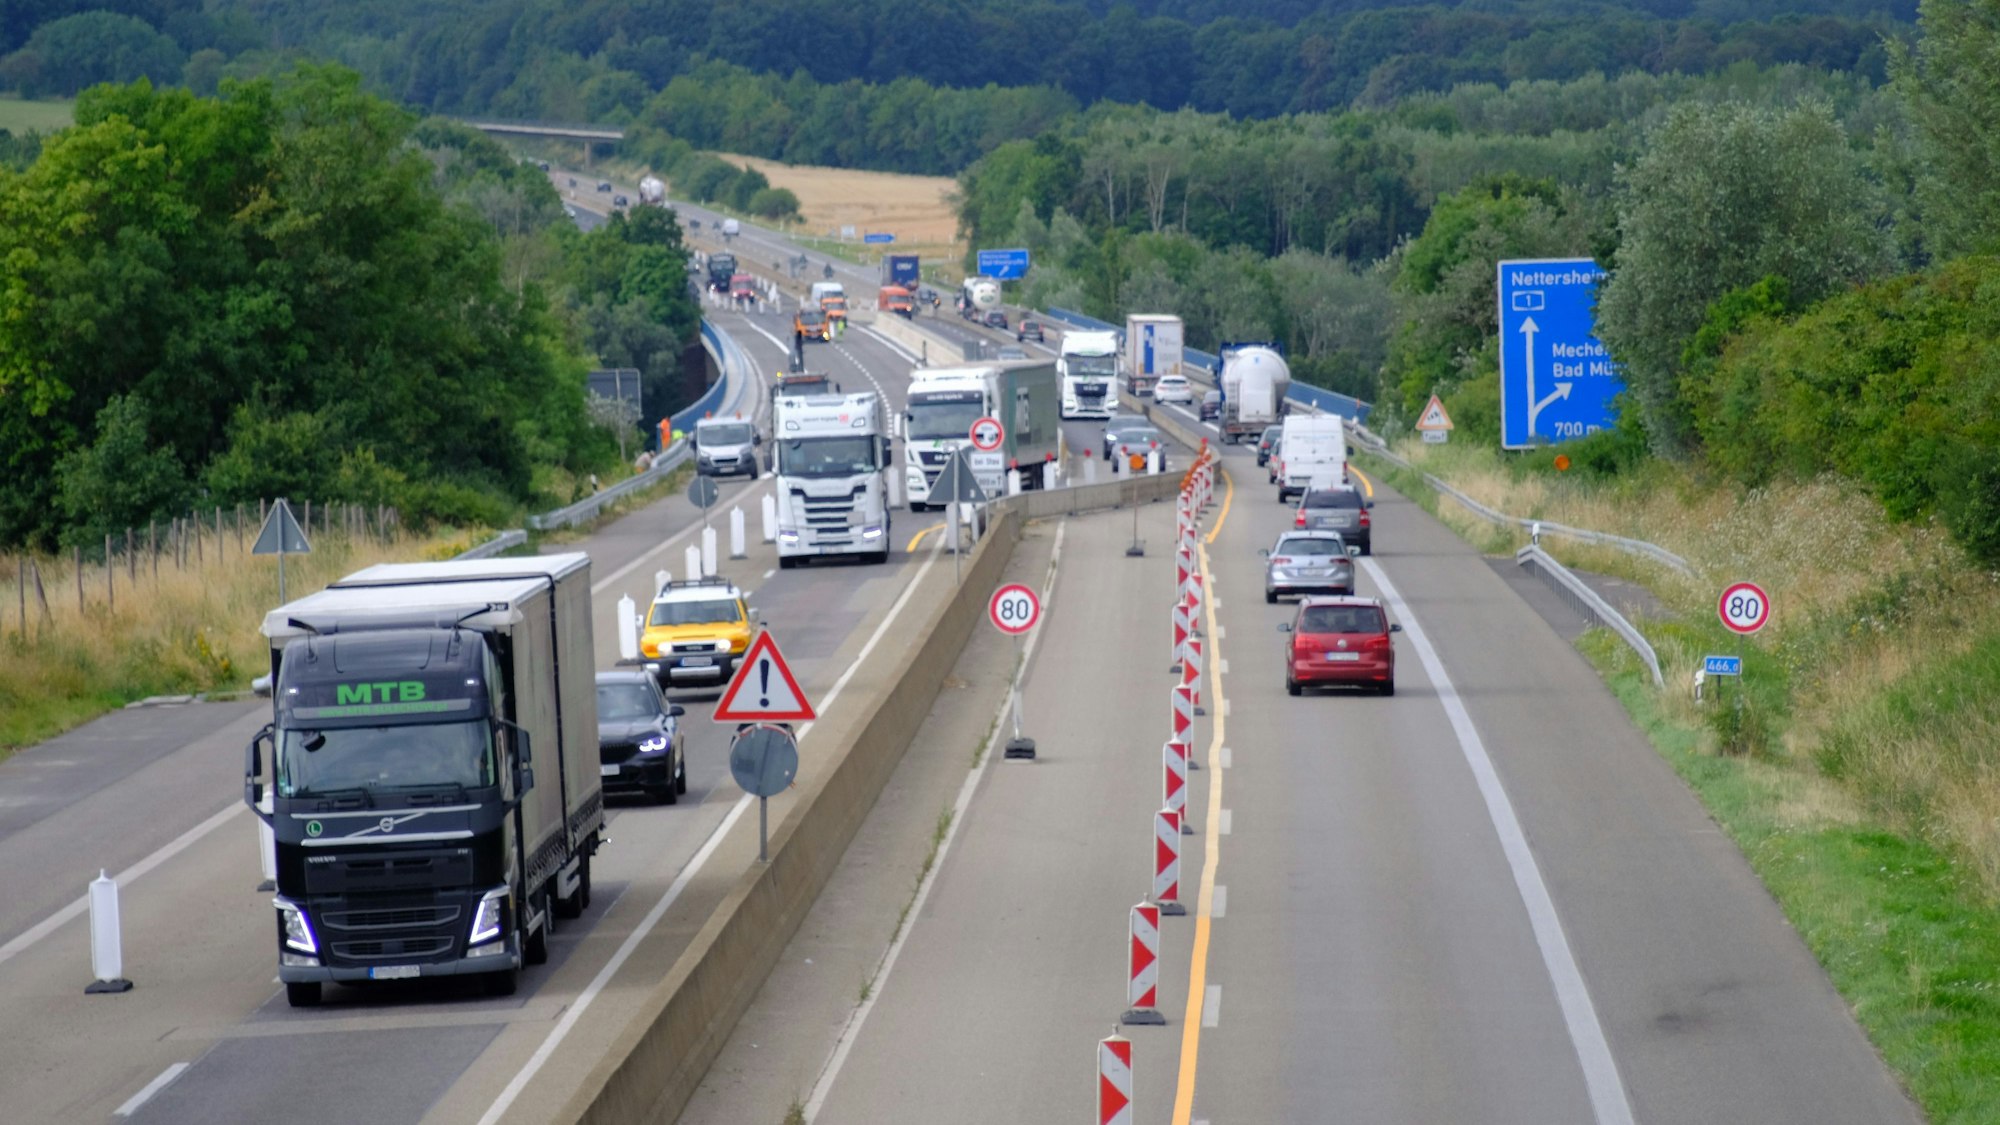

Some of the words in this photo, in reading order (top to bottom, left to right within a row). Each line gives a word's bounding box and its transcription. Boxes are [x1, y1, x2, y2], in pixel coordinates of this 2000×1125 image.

[1525, 294, 1532, 307] 1
[1553, 363, 1583, 378] Bad
[1554, 421, 1583, 437] 700
[1001, 599, 1029, 620] 80
[1730, 596, 1758, 619] 80
[336, 681, 426, 705] MTB
